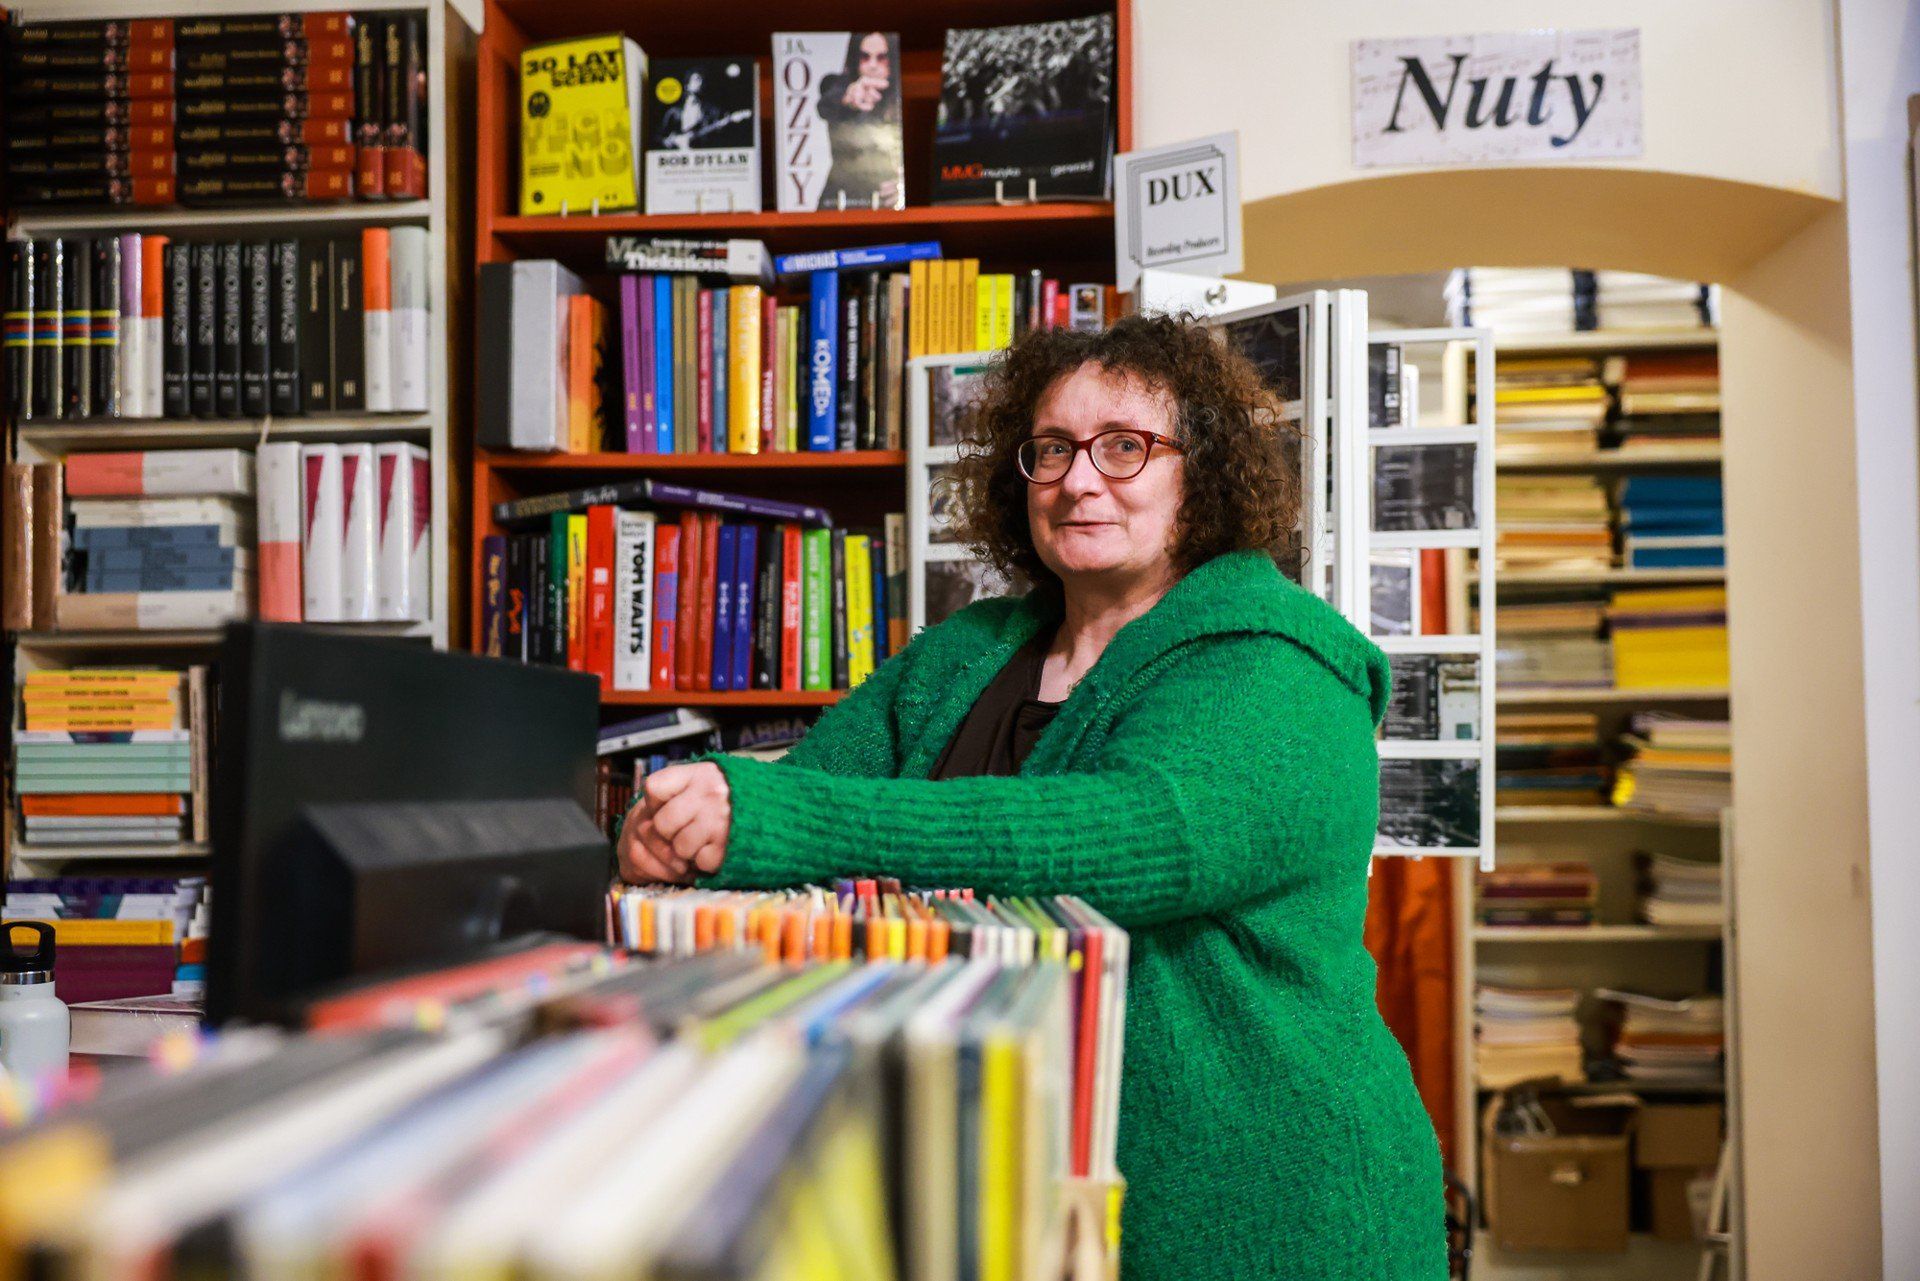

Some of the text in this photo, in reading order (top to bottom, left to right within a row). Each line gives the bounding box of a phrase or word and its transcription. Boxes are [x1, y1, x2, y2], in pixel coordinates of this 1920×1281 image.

[526, 50, 621, 76] 30 LAT
[1382, 53, 1606, 148] Nuty
[784, 56, 813, 206] OZZY
[658, 153, 749, 167] BOB DYLAN
[1148, 166, 1216, 206] DUX
[632, 542, 645, 584] TOM
[630, 590, 645, 654] WAITS
